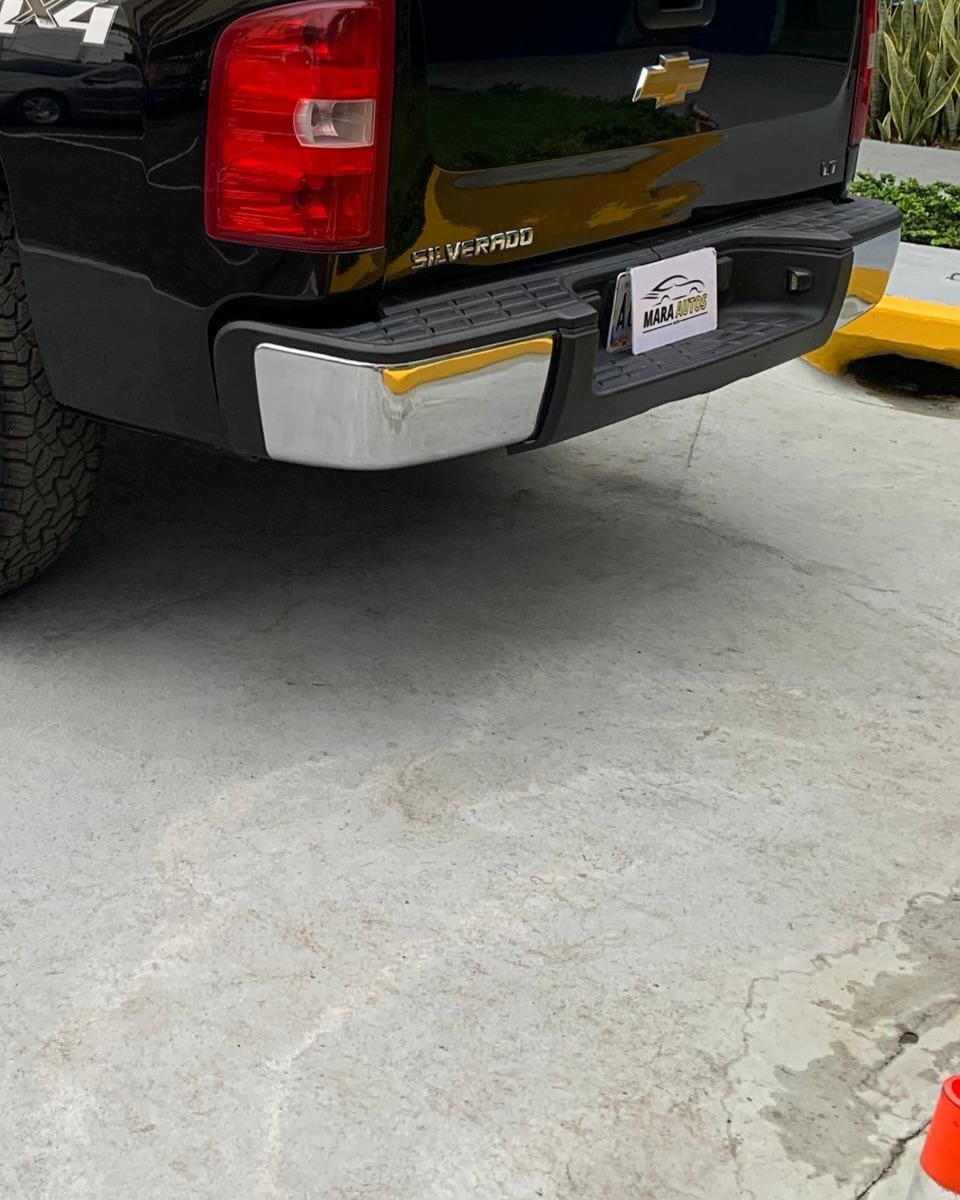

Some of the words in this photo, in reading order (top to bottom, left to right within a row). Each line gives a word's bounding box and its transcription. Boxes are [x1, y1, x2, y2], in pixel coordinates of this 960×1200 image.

[411, 227, 534, 270] SILVERADO
[643, 304, 675, 329] MARA
[674, 294, 708, 319] AUTOS
